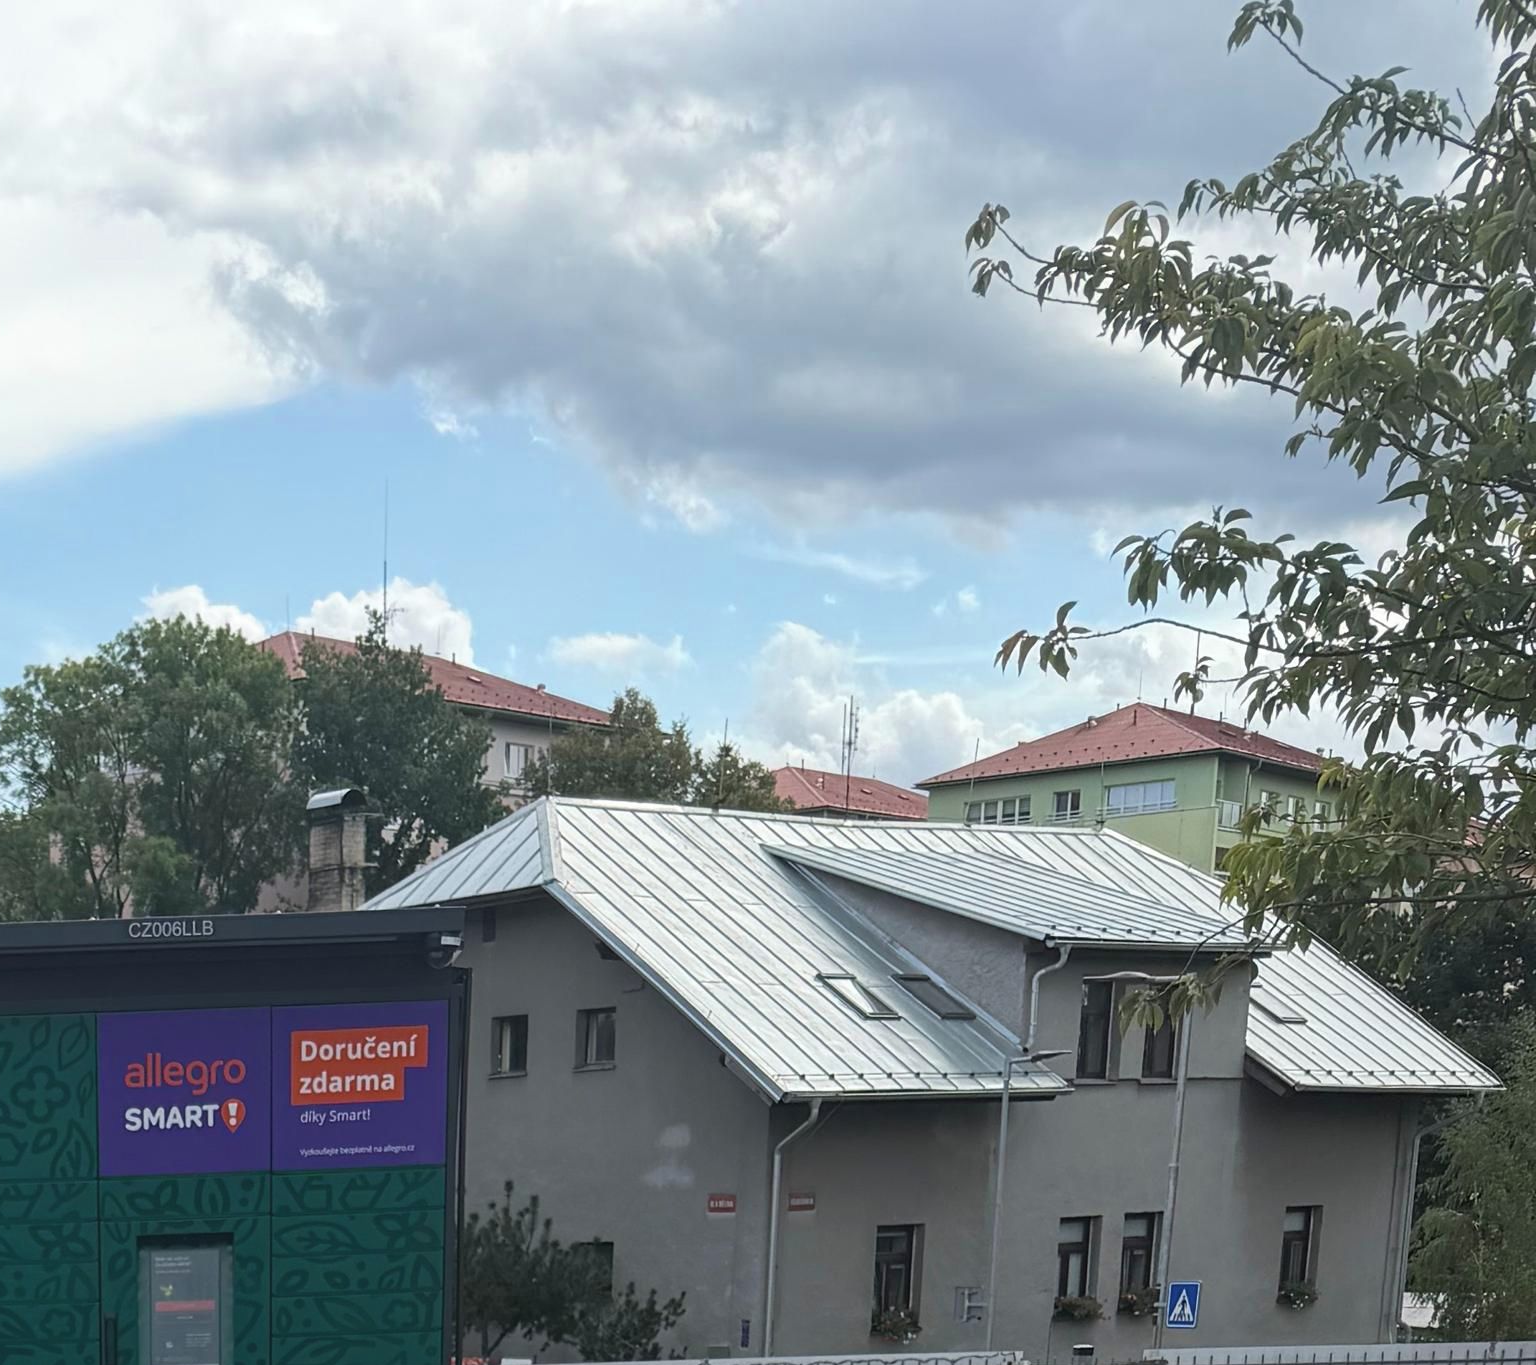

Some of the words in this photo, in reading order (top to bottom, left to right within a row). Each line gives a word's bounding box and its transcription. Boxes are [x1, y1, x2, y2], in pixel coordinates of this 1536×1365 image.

[128, 920, 214, 938] CZ006LLB
[300, 1035, 417, 1062] Doručení
[124, 1053, 246, 1095] allegro
[300, 1070, 395, 1094] zdarma
[300, 1109, 326, 1126] díky
[329, 1109, 371, 1122] Smart!
